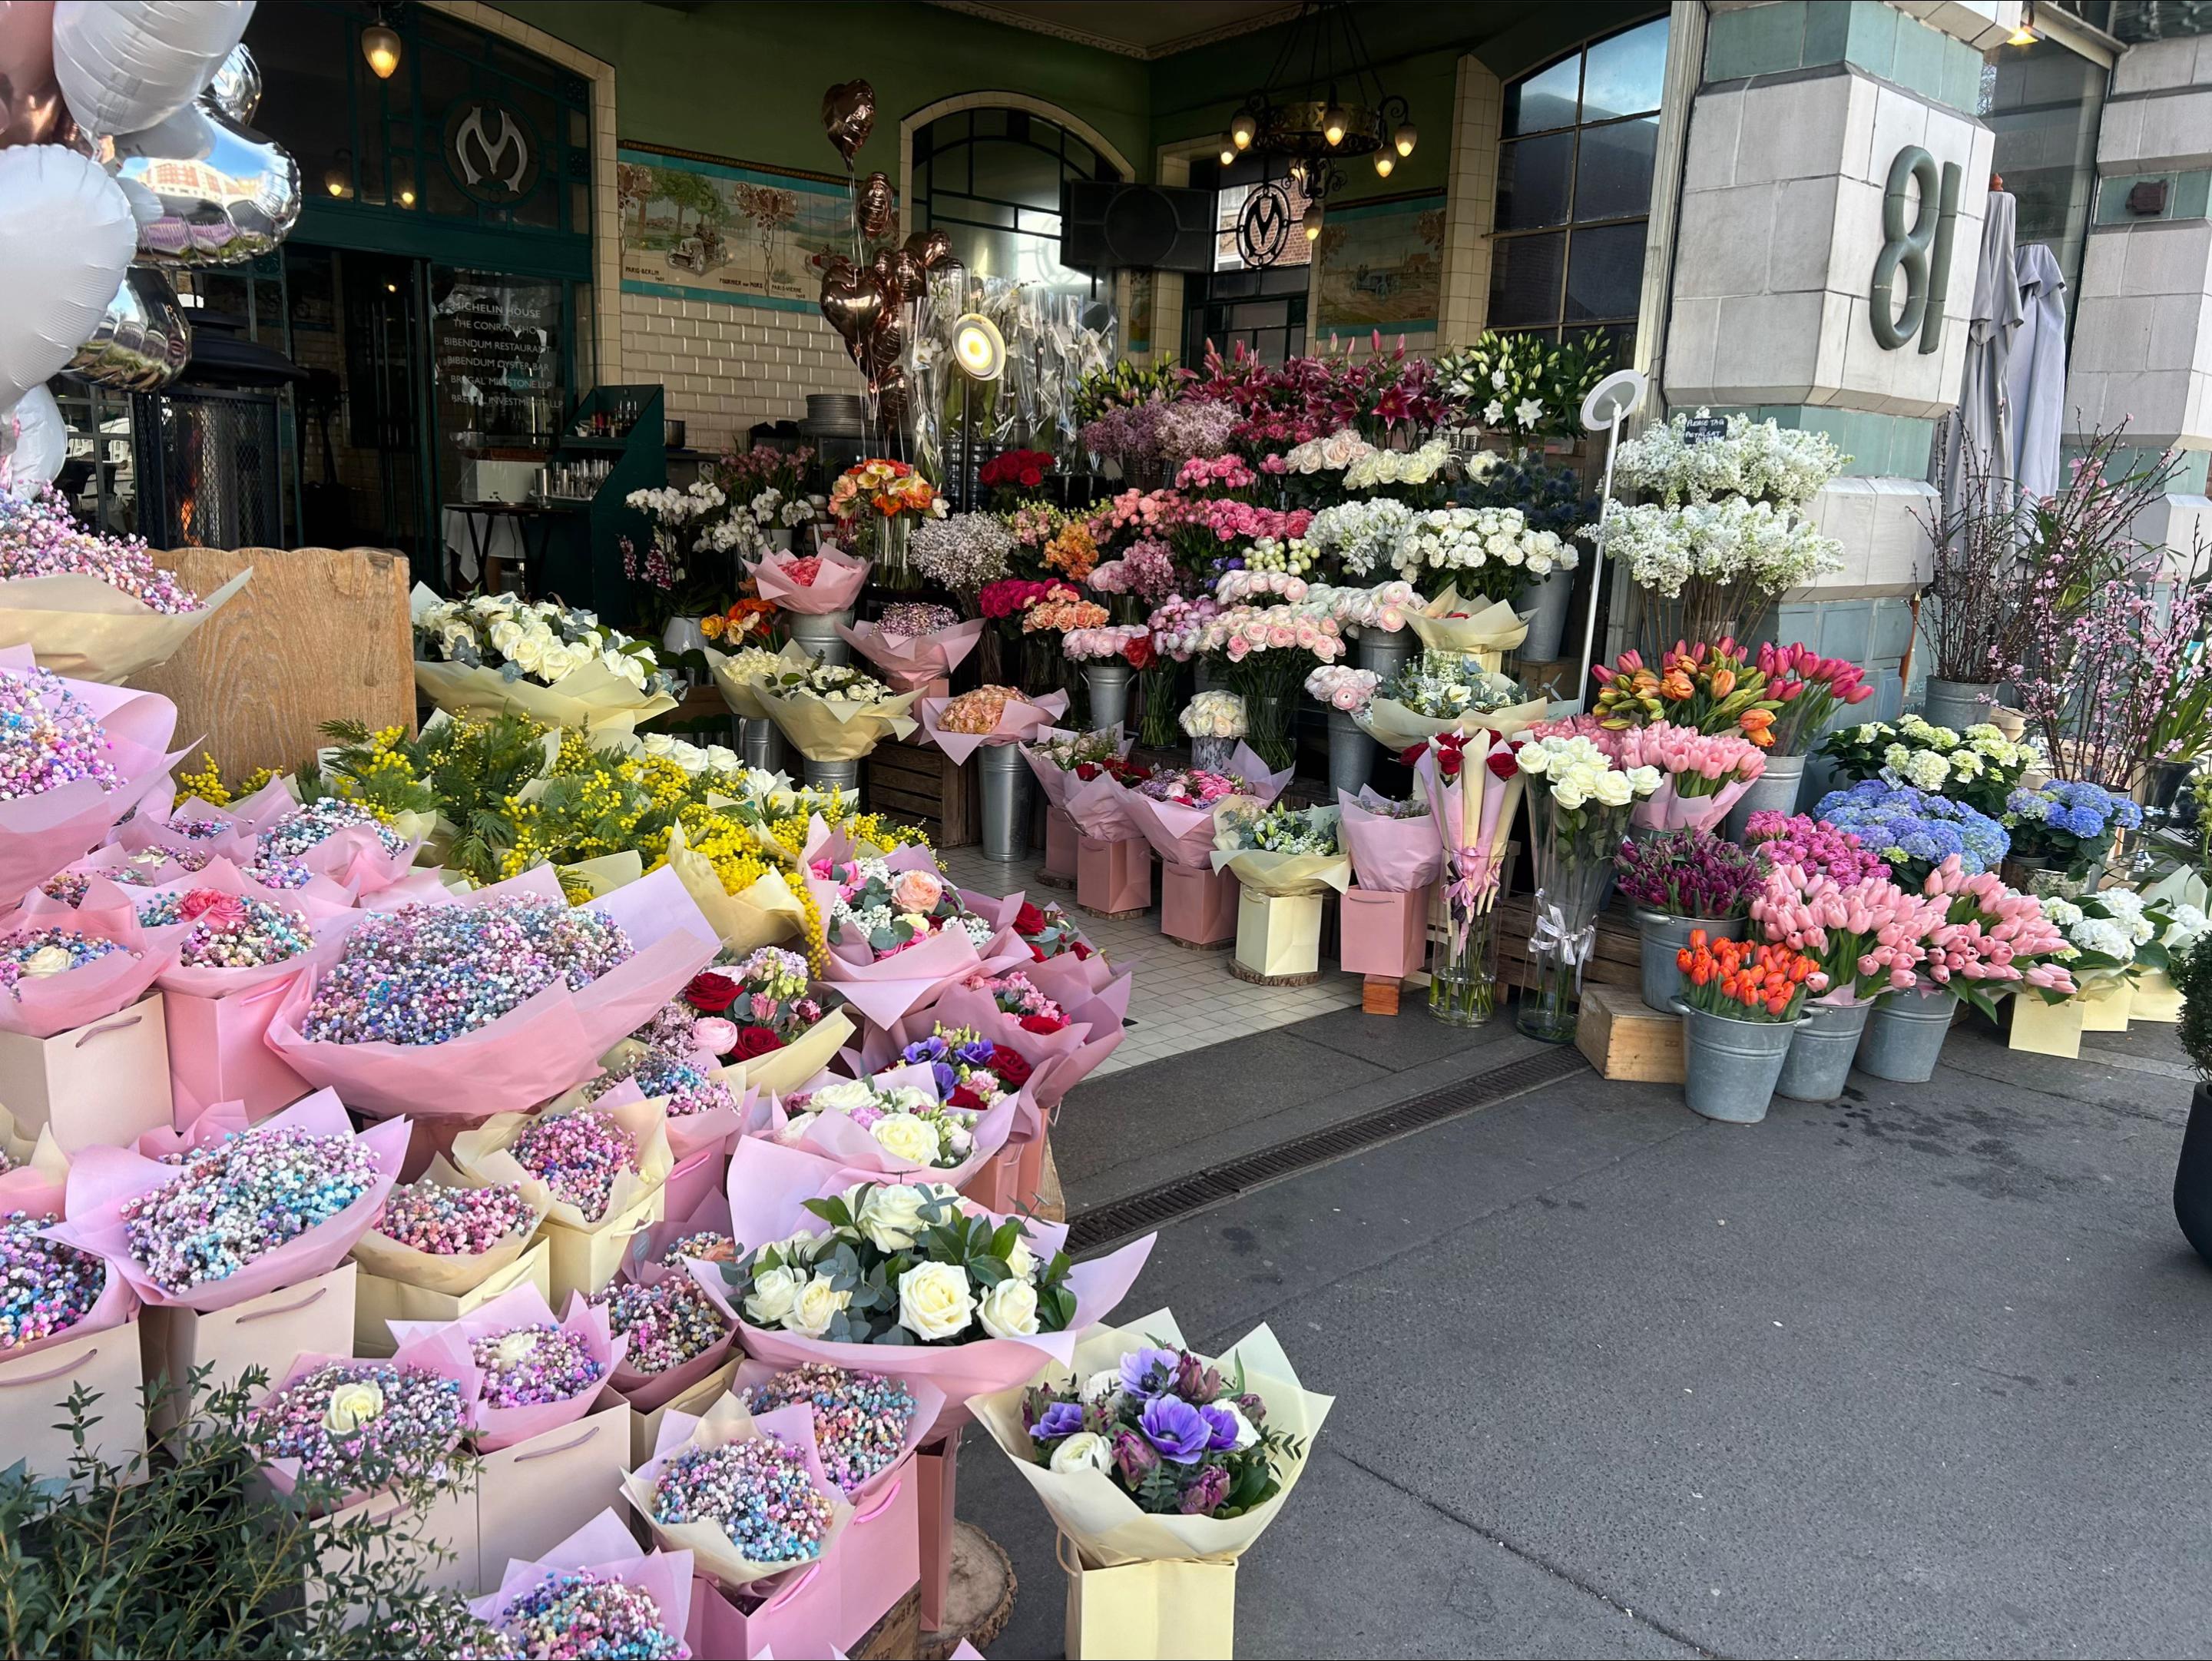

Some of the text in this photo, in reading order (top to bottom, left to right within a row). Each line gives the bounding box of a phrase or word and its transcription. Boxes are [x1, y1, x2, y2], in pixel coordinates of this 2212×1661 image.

[1869, 144, 1962, 355] 81
[625, 267, 660, 276] PARIS-BERLIN
[452, 301, 541, 318] MICHELIN HOUSE
[454, 318, 472, 329] THE
[474, 320, 515, 332] CONRAN
[444, 337, 551, 355] BIBENDUM RESTAURANT
[447, 356, 549, 371] BIBENDUM OYSTER BAR
[451, 375, 485, 385] BRGAL
[452, 394, 487, 405] BREAL
[550, 400, 563, 409] LLP
